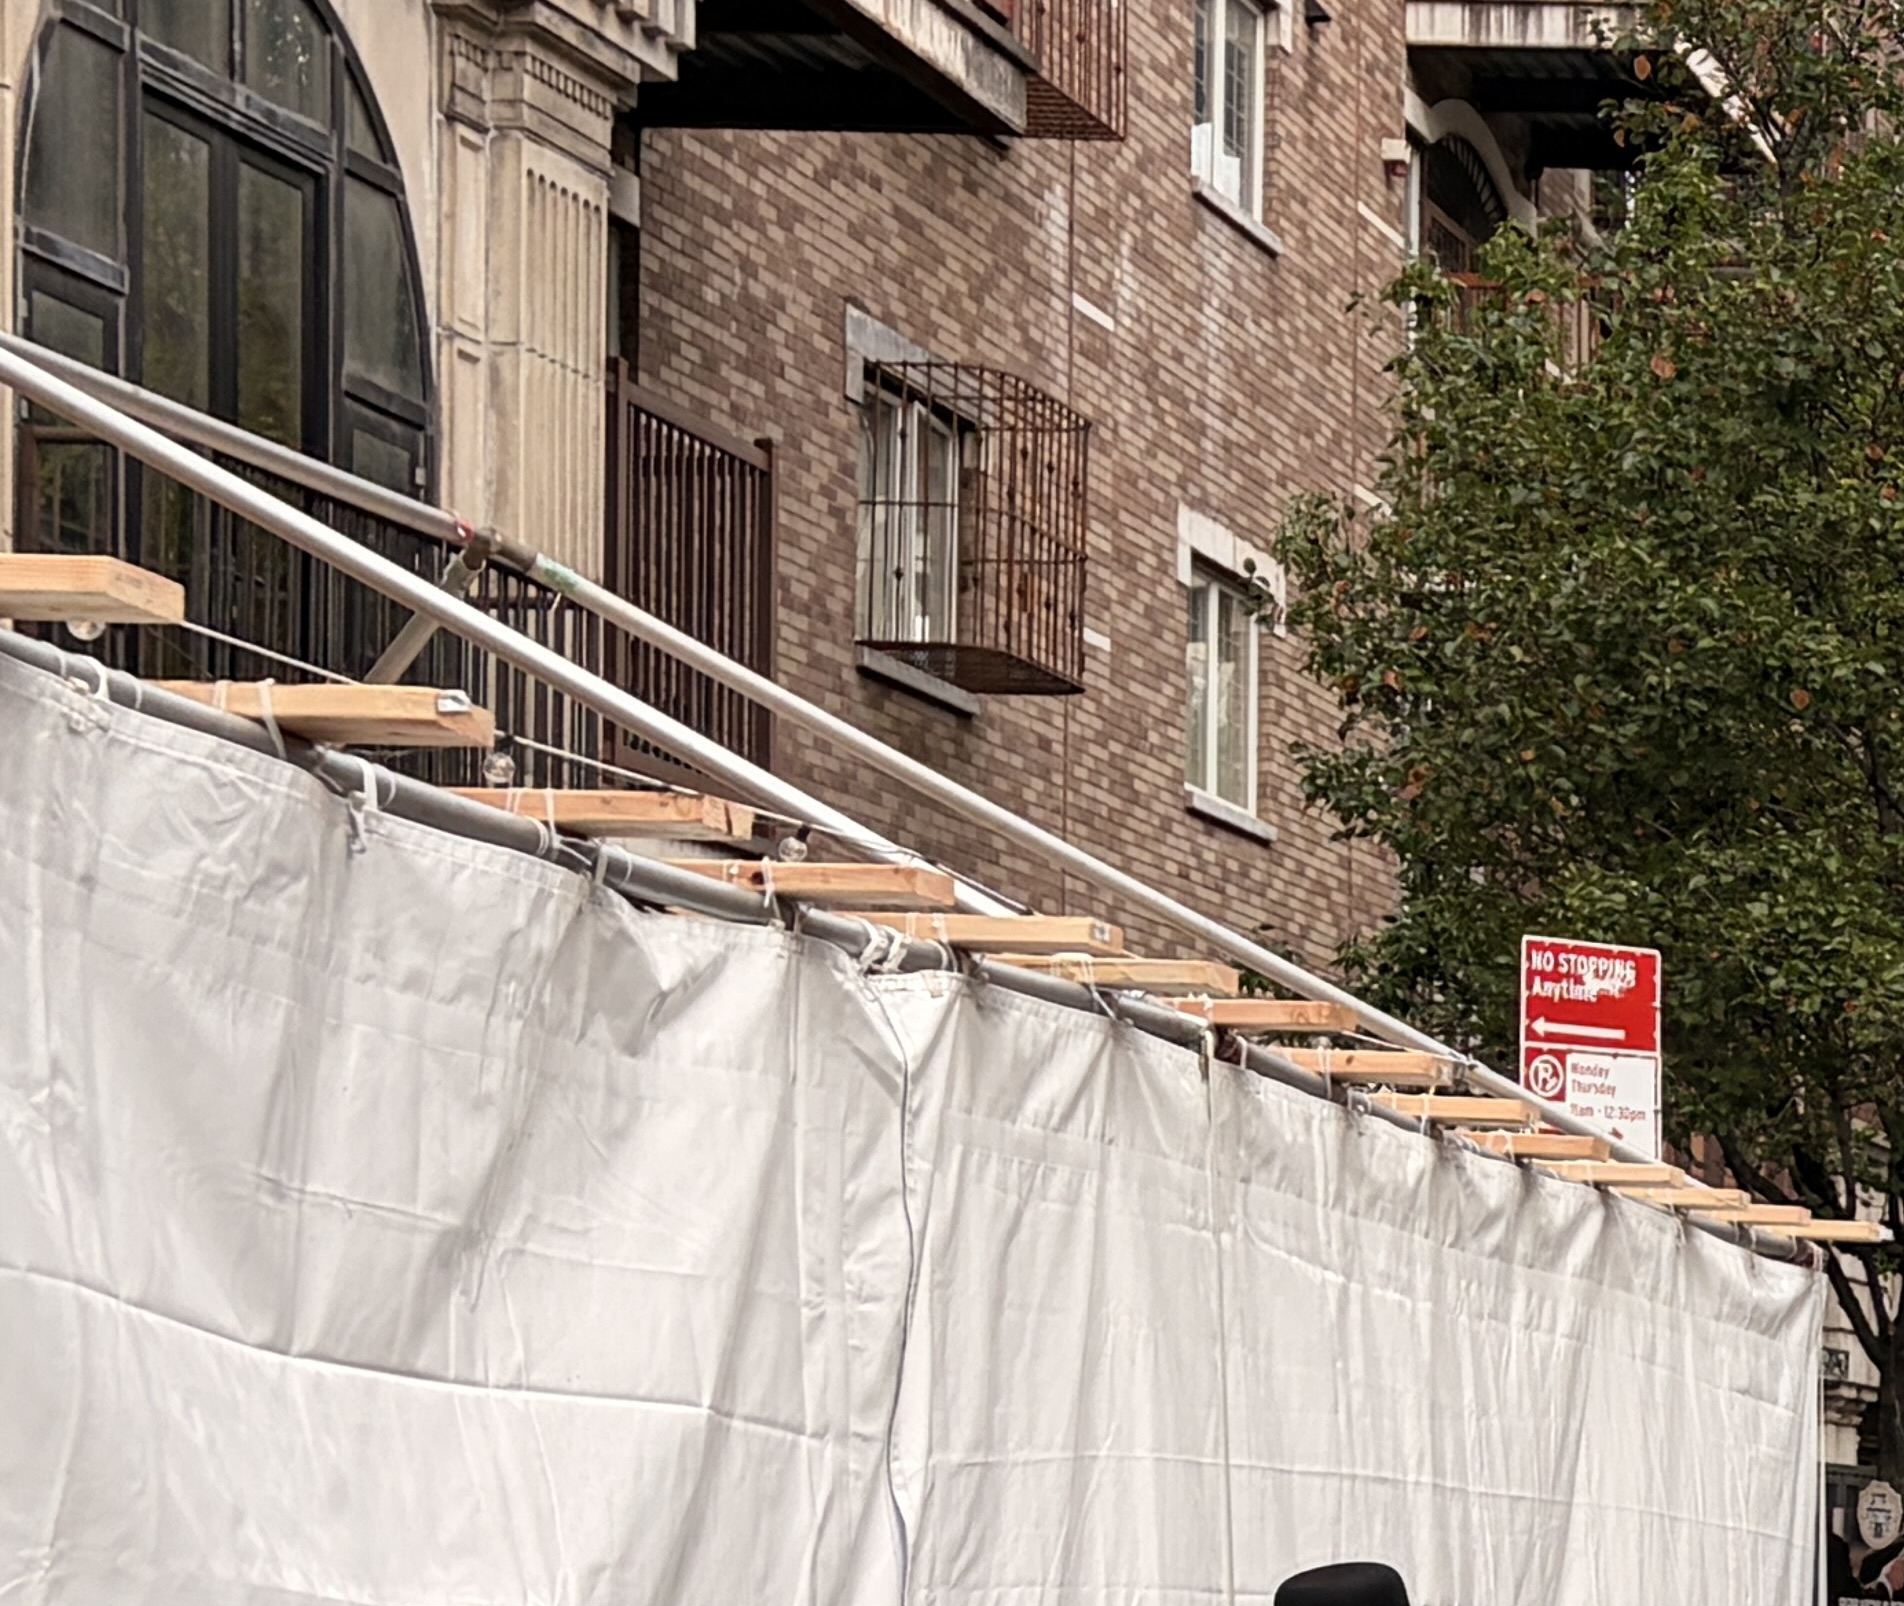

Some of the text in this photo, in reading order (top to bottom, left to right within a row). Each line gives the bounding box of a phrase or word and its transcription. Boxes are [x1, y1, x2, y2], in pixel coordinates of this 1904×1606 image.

[1531, 949, 1554, 972] NO
[1532, 975, 1597, 1003] Anytime
[1571, 1062, 1609, 1079] Monday
[1571, 1079, 1616, 1098] Thursday
